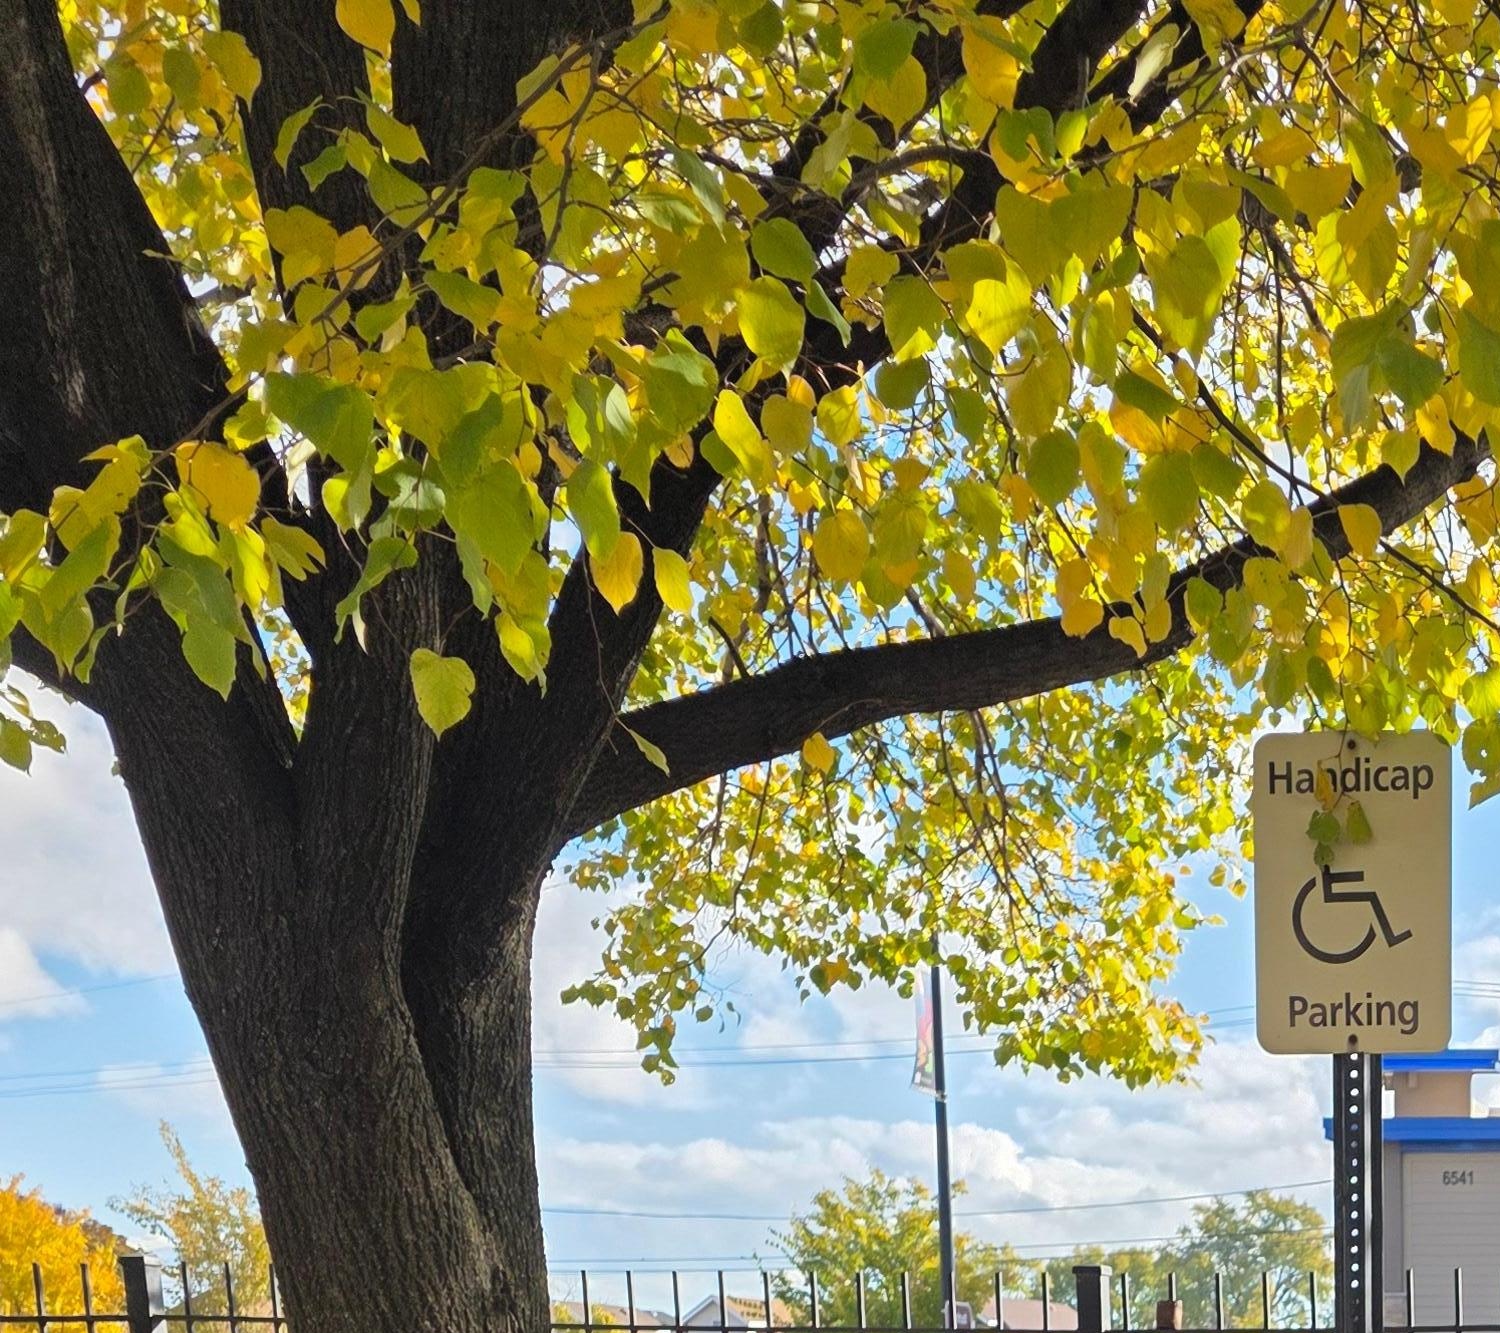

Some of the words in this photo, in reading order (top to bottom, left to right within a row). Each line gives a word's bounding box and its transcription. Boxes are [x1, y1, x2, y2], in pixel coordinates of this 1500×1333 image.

[1268, 757, 1434, 800] Handicap
[1289, 993, 1419, 1035] Parking
[1442, 1170, 1474, 1185] 6541
